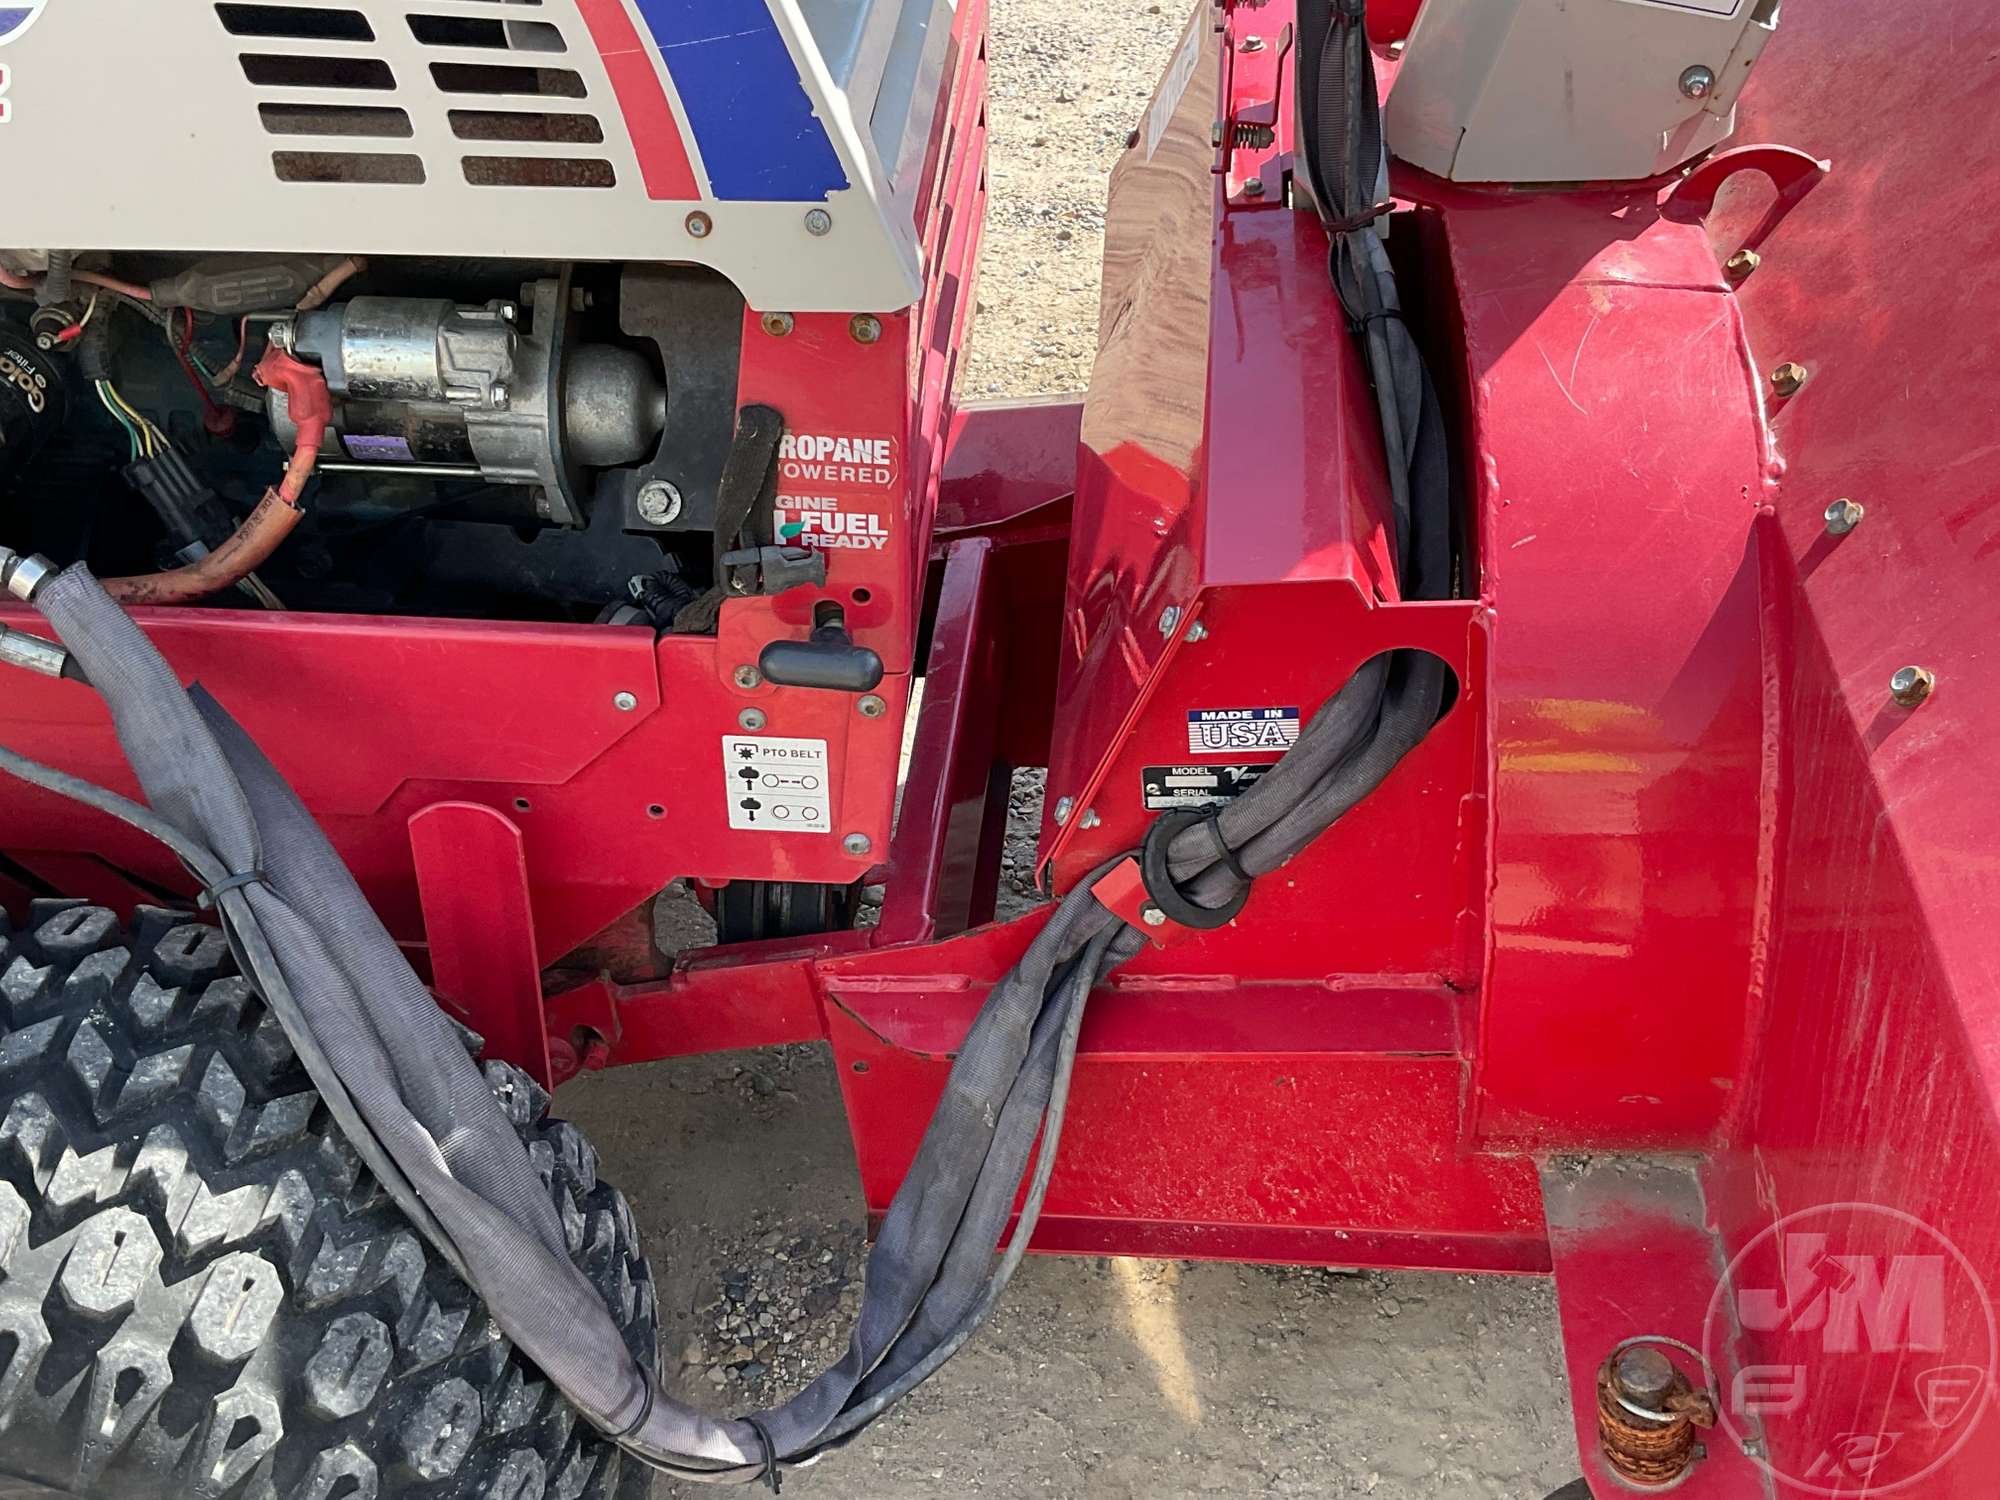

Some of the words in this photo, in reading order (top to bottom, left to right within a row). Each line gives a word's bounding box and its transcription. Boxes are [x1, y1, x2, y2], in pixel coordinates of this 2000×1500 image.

[778, 434, 891, 465] ROPANE
[778, 462, 891, 484] OWERED
[775, 495, 838, 511] GINE
[801, 533, 889, 551] READY
[1201, 710, 1253, 721] MADE
[1263, 709, 1284, 719] IN
[1199, 721, 1289, 749] USA
[763, 748, 788, 758] PTO
[790, 749, 822, 759] BELT
[1172, 766, 1212, 776] MODEL
[1173, 788, 1212, 798] SERIAL
